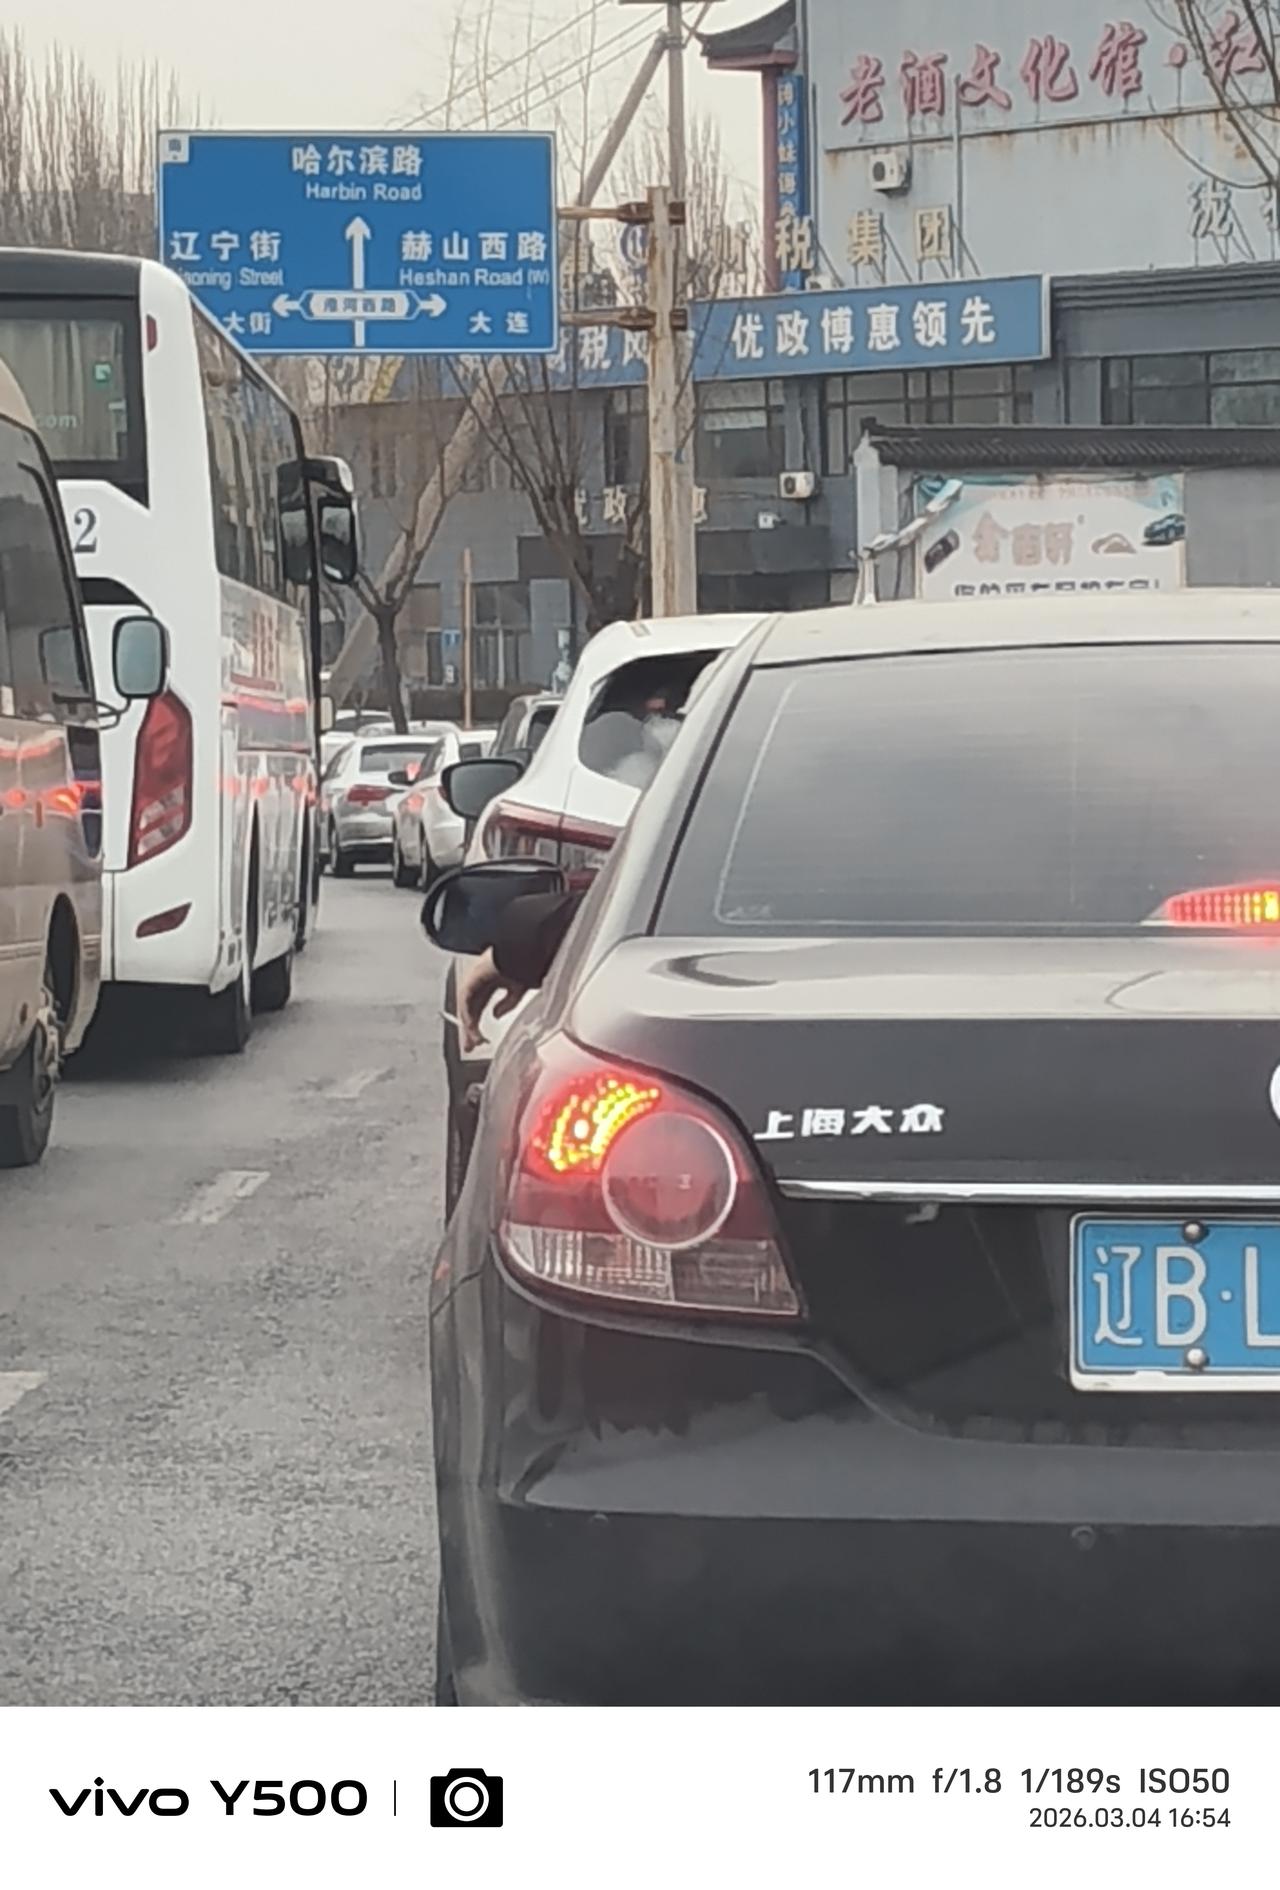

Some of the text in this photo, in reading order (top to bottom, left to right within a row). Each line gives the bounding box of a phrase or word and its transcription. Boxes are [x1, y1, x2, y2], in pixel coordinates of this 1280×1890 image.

[292, 144, 424, 176] 哈尔滨路
[306, 183, 423, 201] Harbin Road
[169, 231, 281, 262] 辽宁街
[401, 231, 548, 262] 赫山西路
[240, 266, 284, 287] Street
[400, 268, 470, 286] Heshan
[474, 268, 523, 286] Road
[469, 311, 530, 335] 大连
[731, 295, 997, 360] 优政博惠领先
[754, 1103, 945, 1140] 上海大众
